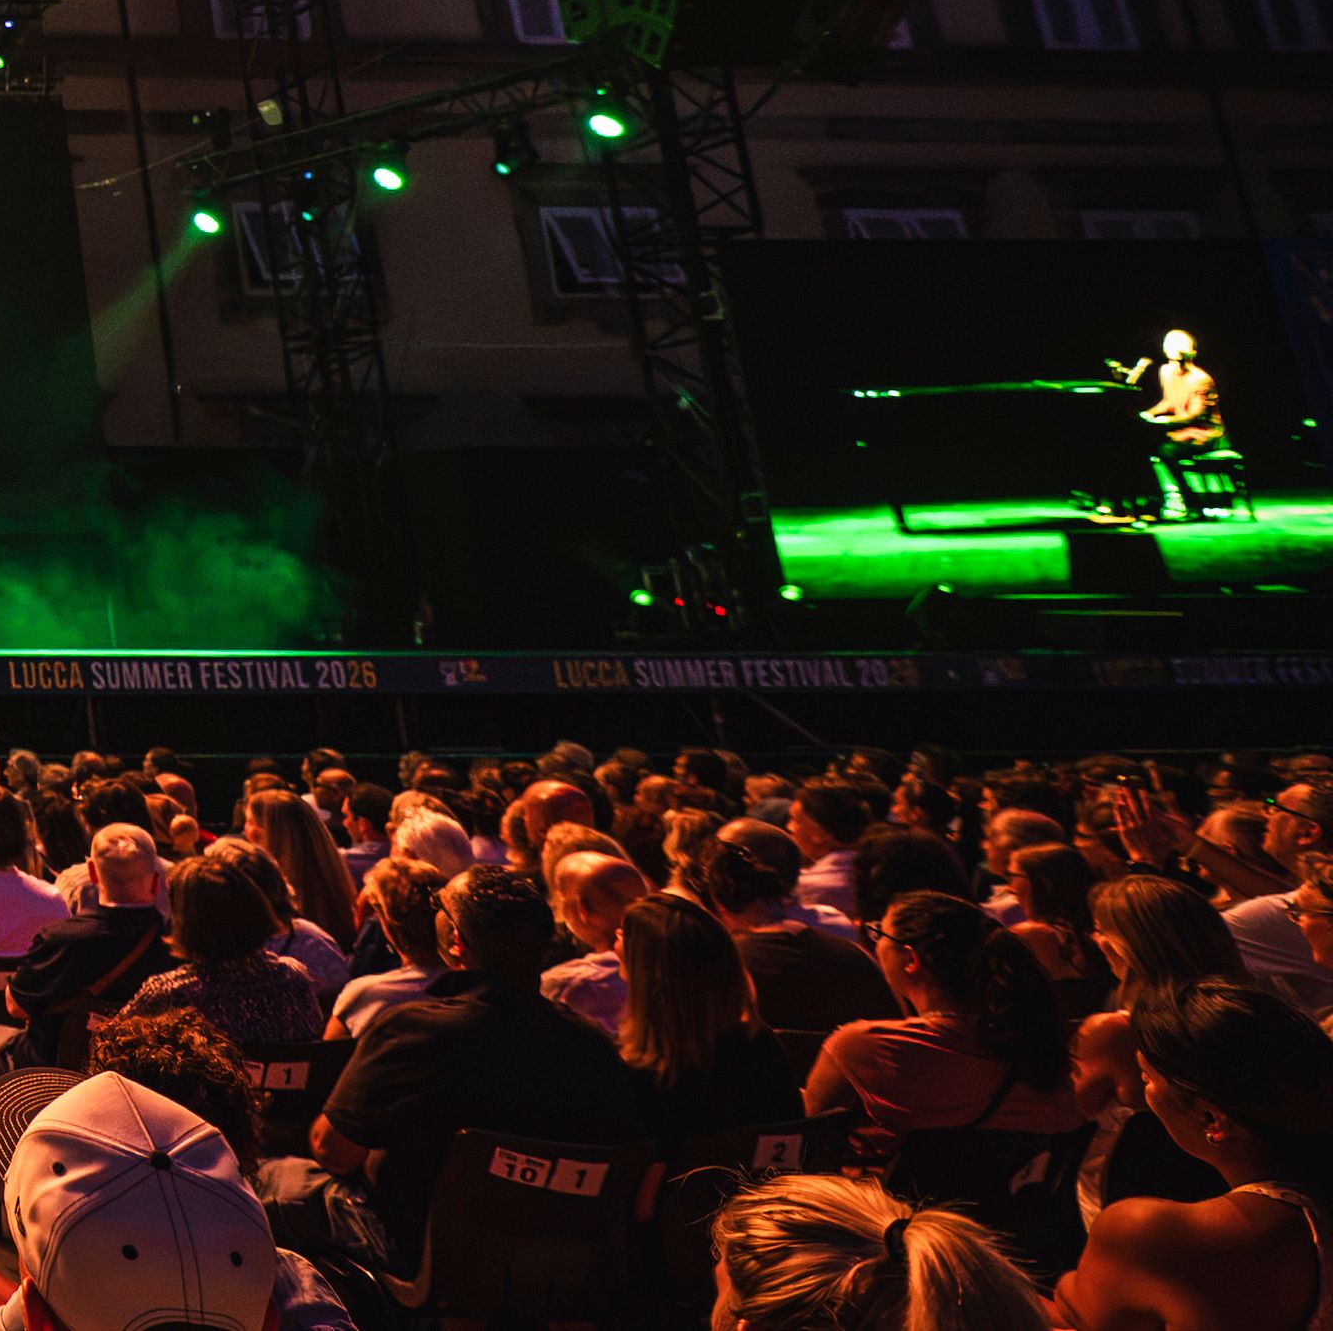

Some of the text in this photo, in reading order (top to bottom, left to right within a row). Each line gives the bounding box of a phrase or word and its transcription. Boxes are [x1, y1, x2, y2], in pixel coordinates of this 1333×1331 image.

[7, 659, 378, 690] LUCCA SUMMER FESTIVAL 2026
[551, 659, 630, 688] LUCCA
[633, 659, 736, 688] SUMMER
[740, 658, 854, 687] FESTIVAL
[284, 1068, 292, 1085] 1
[771, 1142, 787, 1163] 2
[505, 1162, 537, 1183] 10
[575, 1169, 588, 1188] 1
